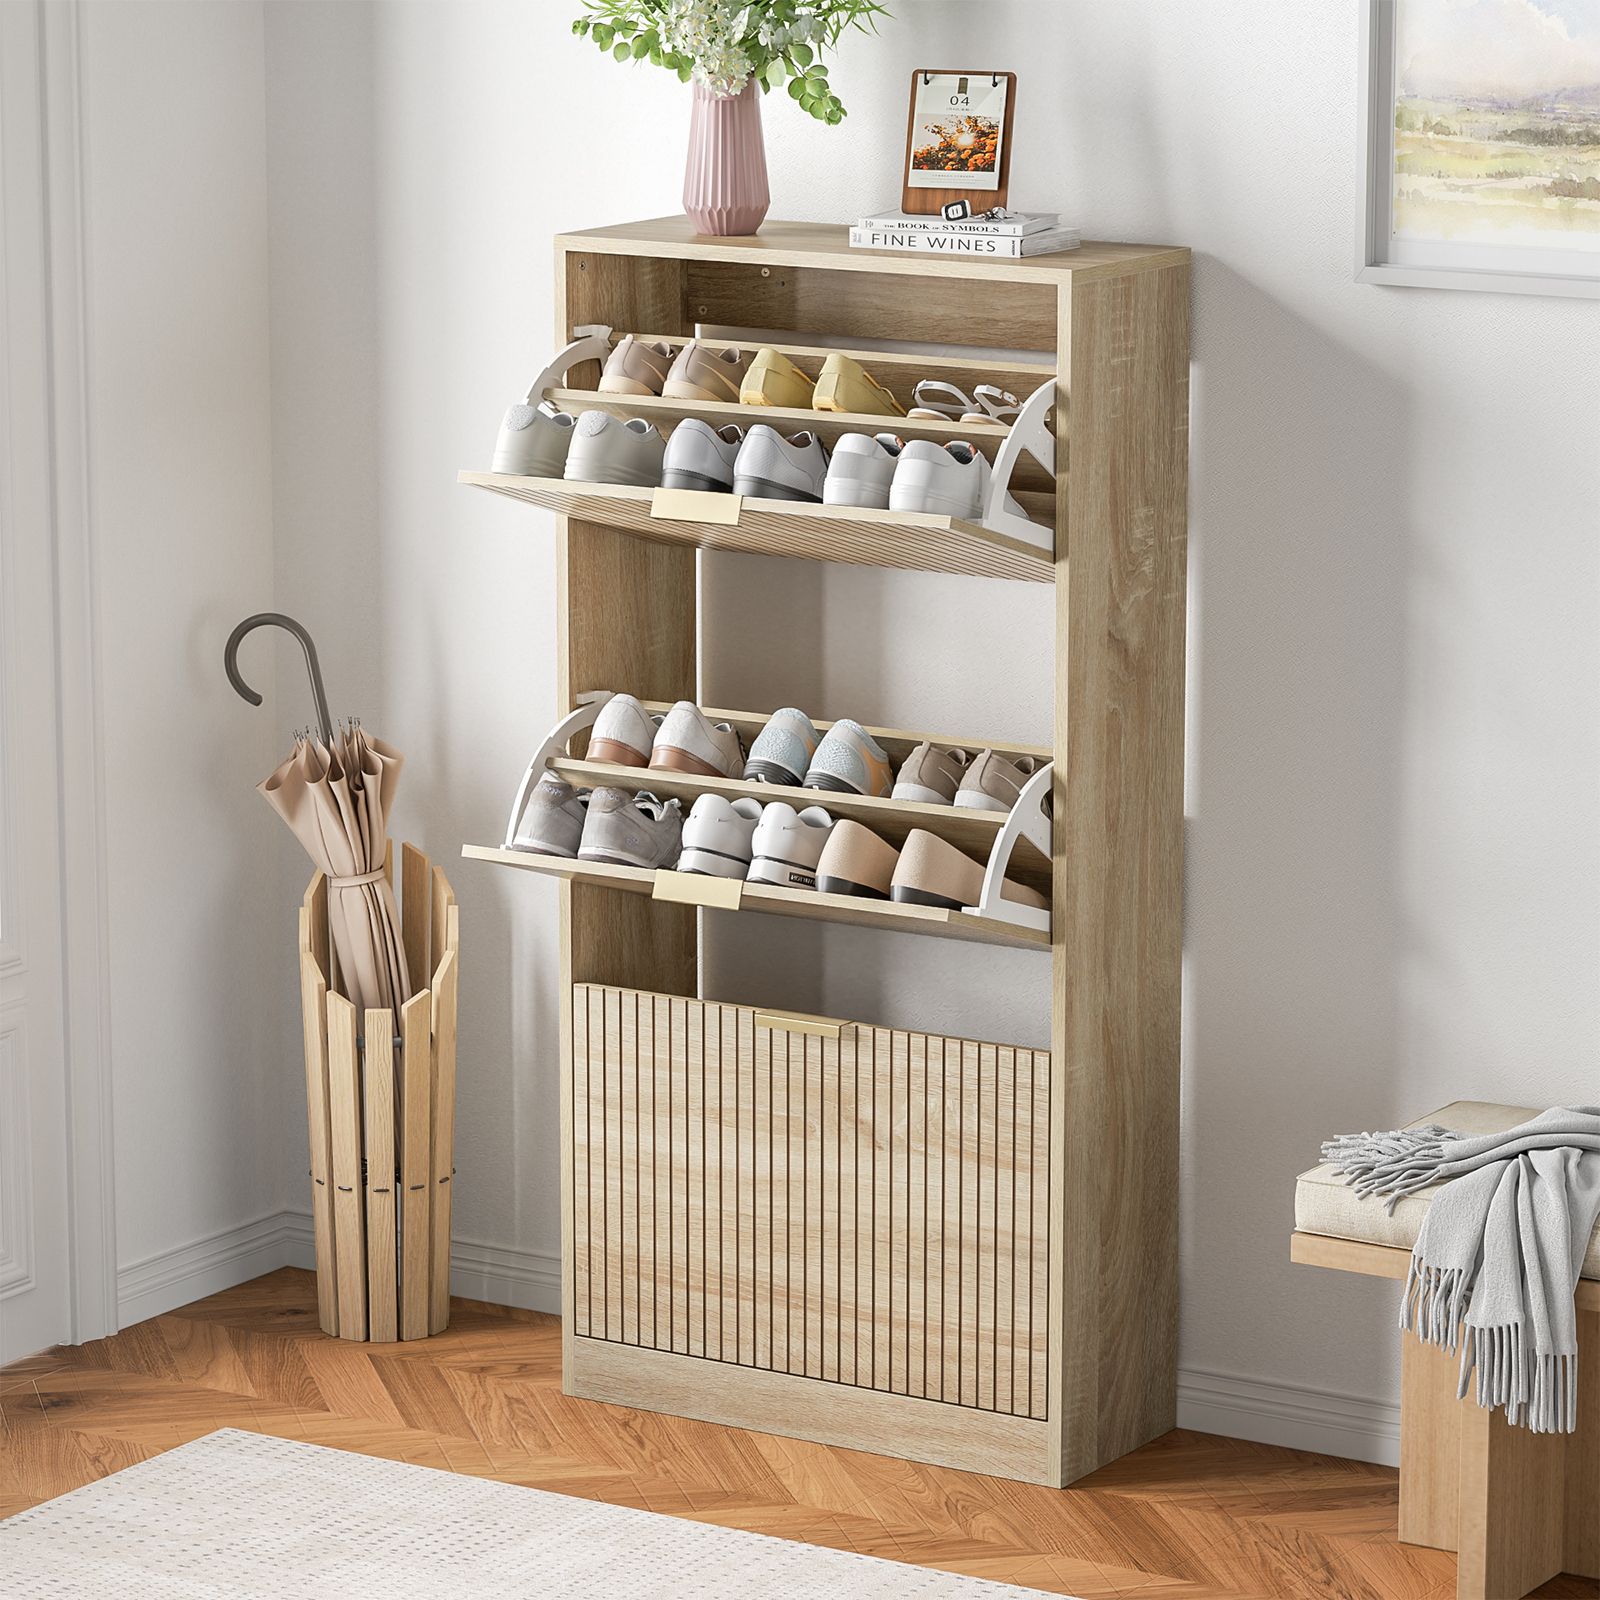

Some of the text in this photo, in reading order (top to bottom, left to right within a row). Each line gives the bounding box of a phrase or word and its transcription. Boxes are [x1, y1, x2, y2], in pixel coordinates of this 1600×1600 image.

[949, 95, 970, 106] 04
[897, 222, 930, 230] BOOK
[942, 224, 1000, 233] SYMBOLS
[871, 233, 917, 247] FINE
[926, 236, 997, 252] WINES
